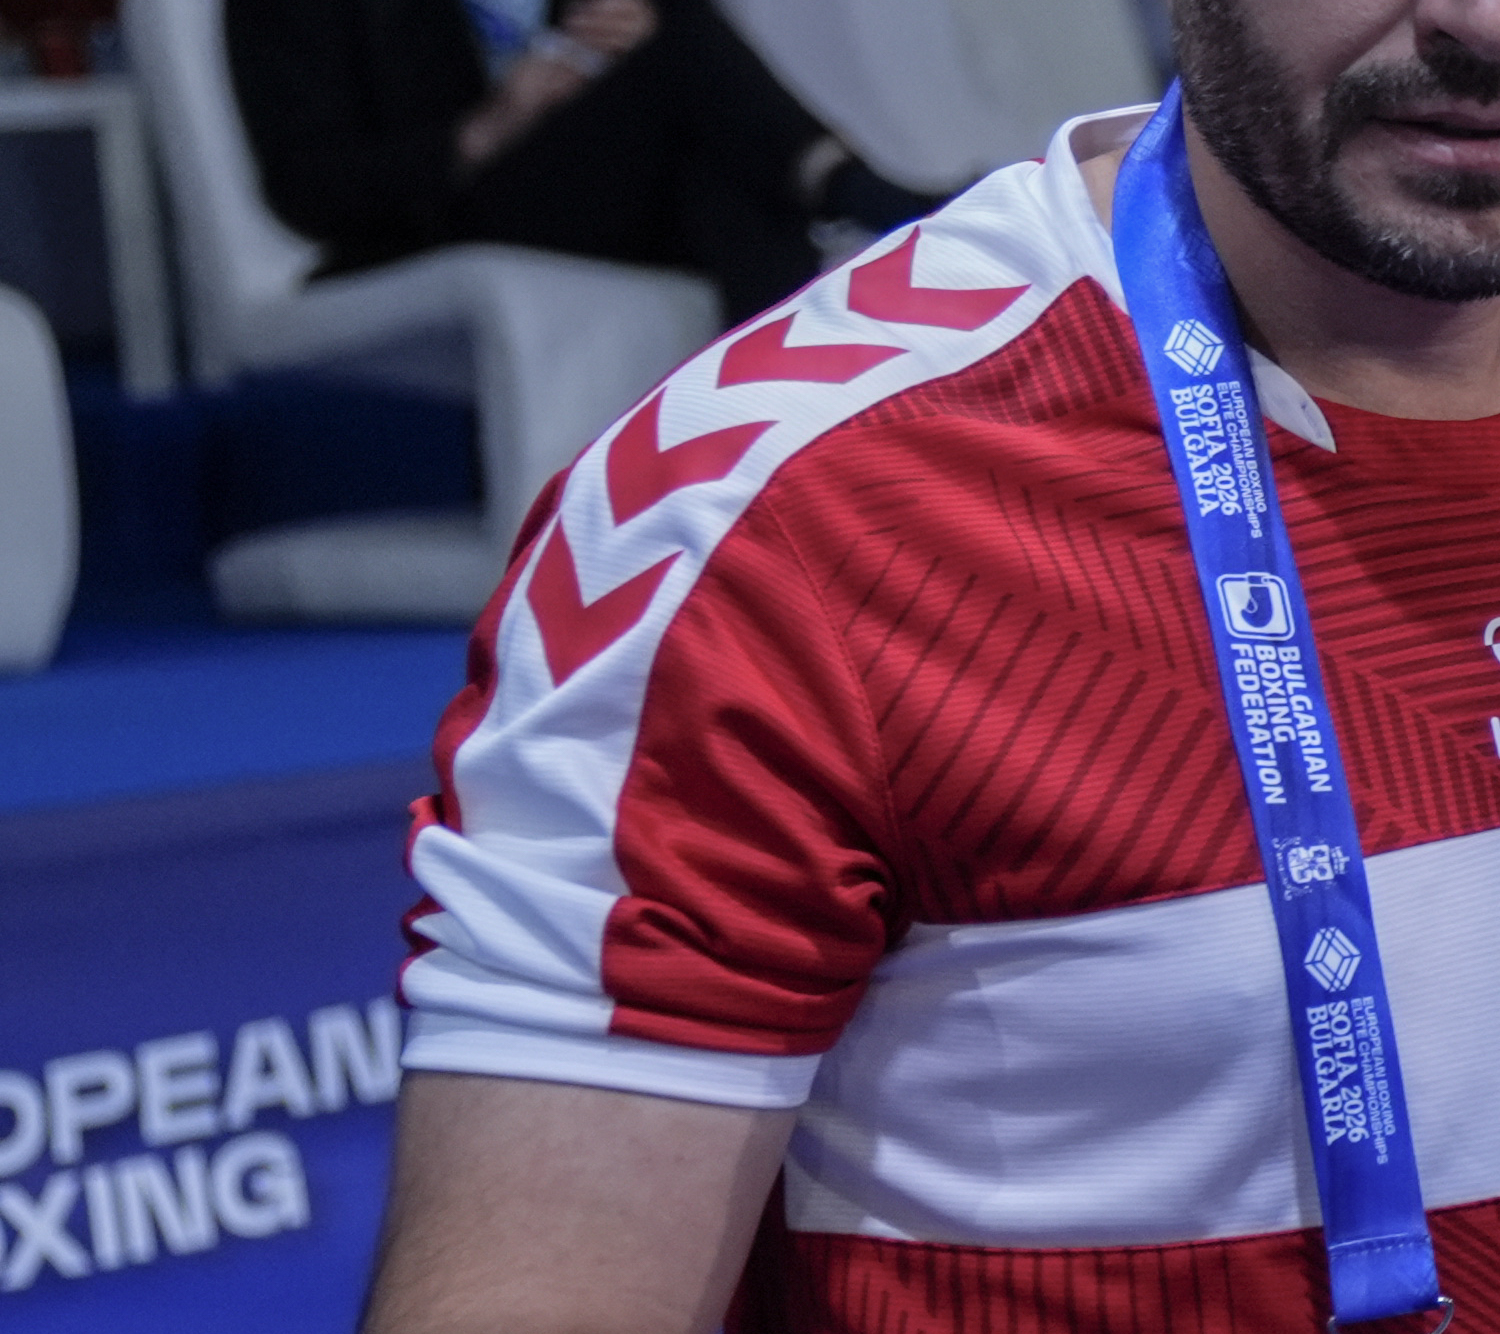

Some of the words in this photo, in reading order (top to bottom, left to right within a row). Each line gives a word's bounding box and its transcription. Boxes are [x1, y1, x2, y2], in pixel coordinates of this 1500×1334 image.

[1170, 388, 1220, 517] BULGARIA
[1192, 384, 1227, 458] SOFIA
[1211, 463, 1242, 515] 2026
[1216, 383, 1235, 419] ELITE
[1226, 423, 1263, 538] CHAMPIONSHIPS
[1229, 381, 1255, 458] EUROPEAN
[1246, 461, 1267, 513] BOXING
[1230, 644, 1287, 804] FEDERATION
[1254, 645, 1296, 742] BOXING
[1278, 646, 1333, 792] BULGARIAN
[1306, 1004, 1347, 1146] BULGARIA
[1328, 1001, 1358, 1081] SOFIA
[1351, 998, 1368, 1039] ELITE
[1363, 996, 1386, 1078] EUROPEAN
[1377, 1080, 1396, 1136] BOXING
[1341, 1085, 1369, 1143] 2026
[1358, 1042, 1388, 1164] CHAMPIONSHIPS
[0, 1130, 310, 1293] XING
